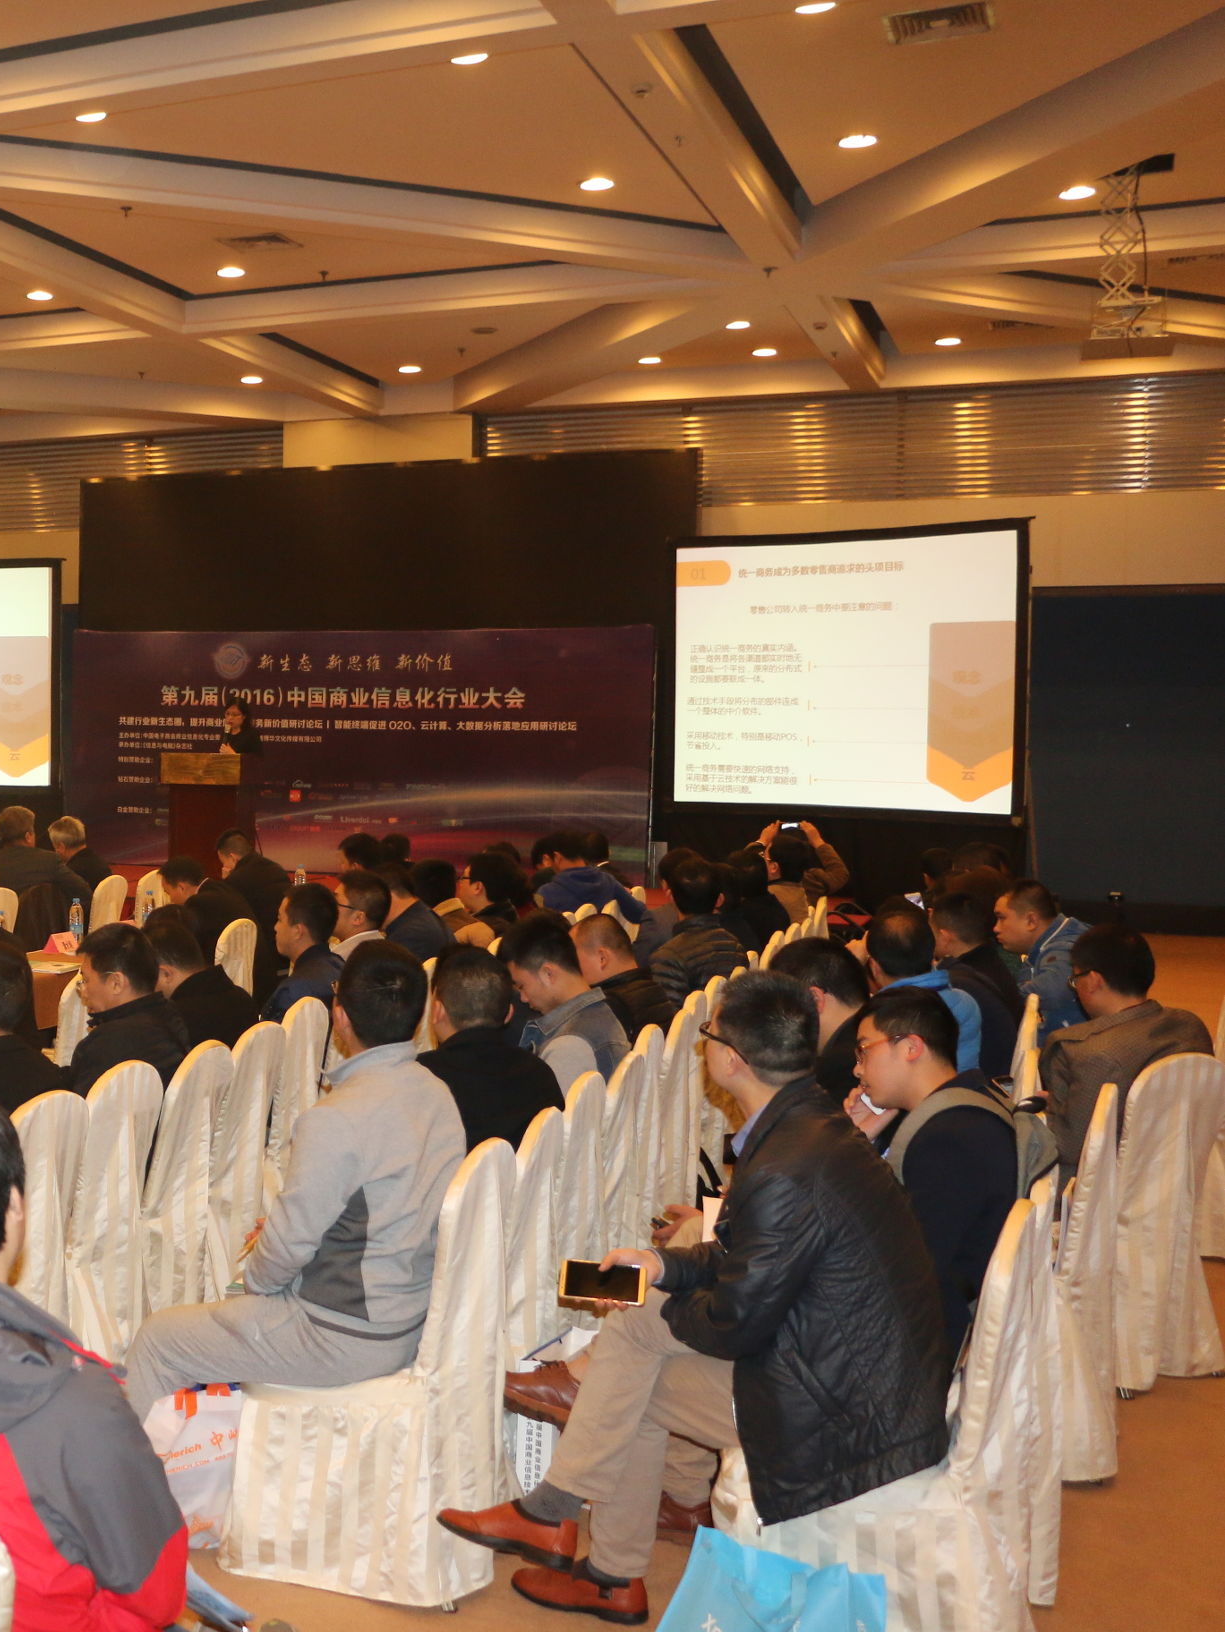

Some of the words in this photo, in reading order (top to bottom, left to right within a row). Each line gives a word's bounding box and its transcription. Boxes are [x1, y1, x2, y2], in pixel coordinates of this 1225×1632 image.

[257, 654, 312, 673] 新生态
[325, 653, 382, 673] 新思维
[395, 653, 453, 673] 新价值
